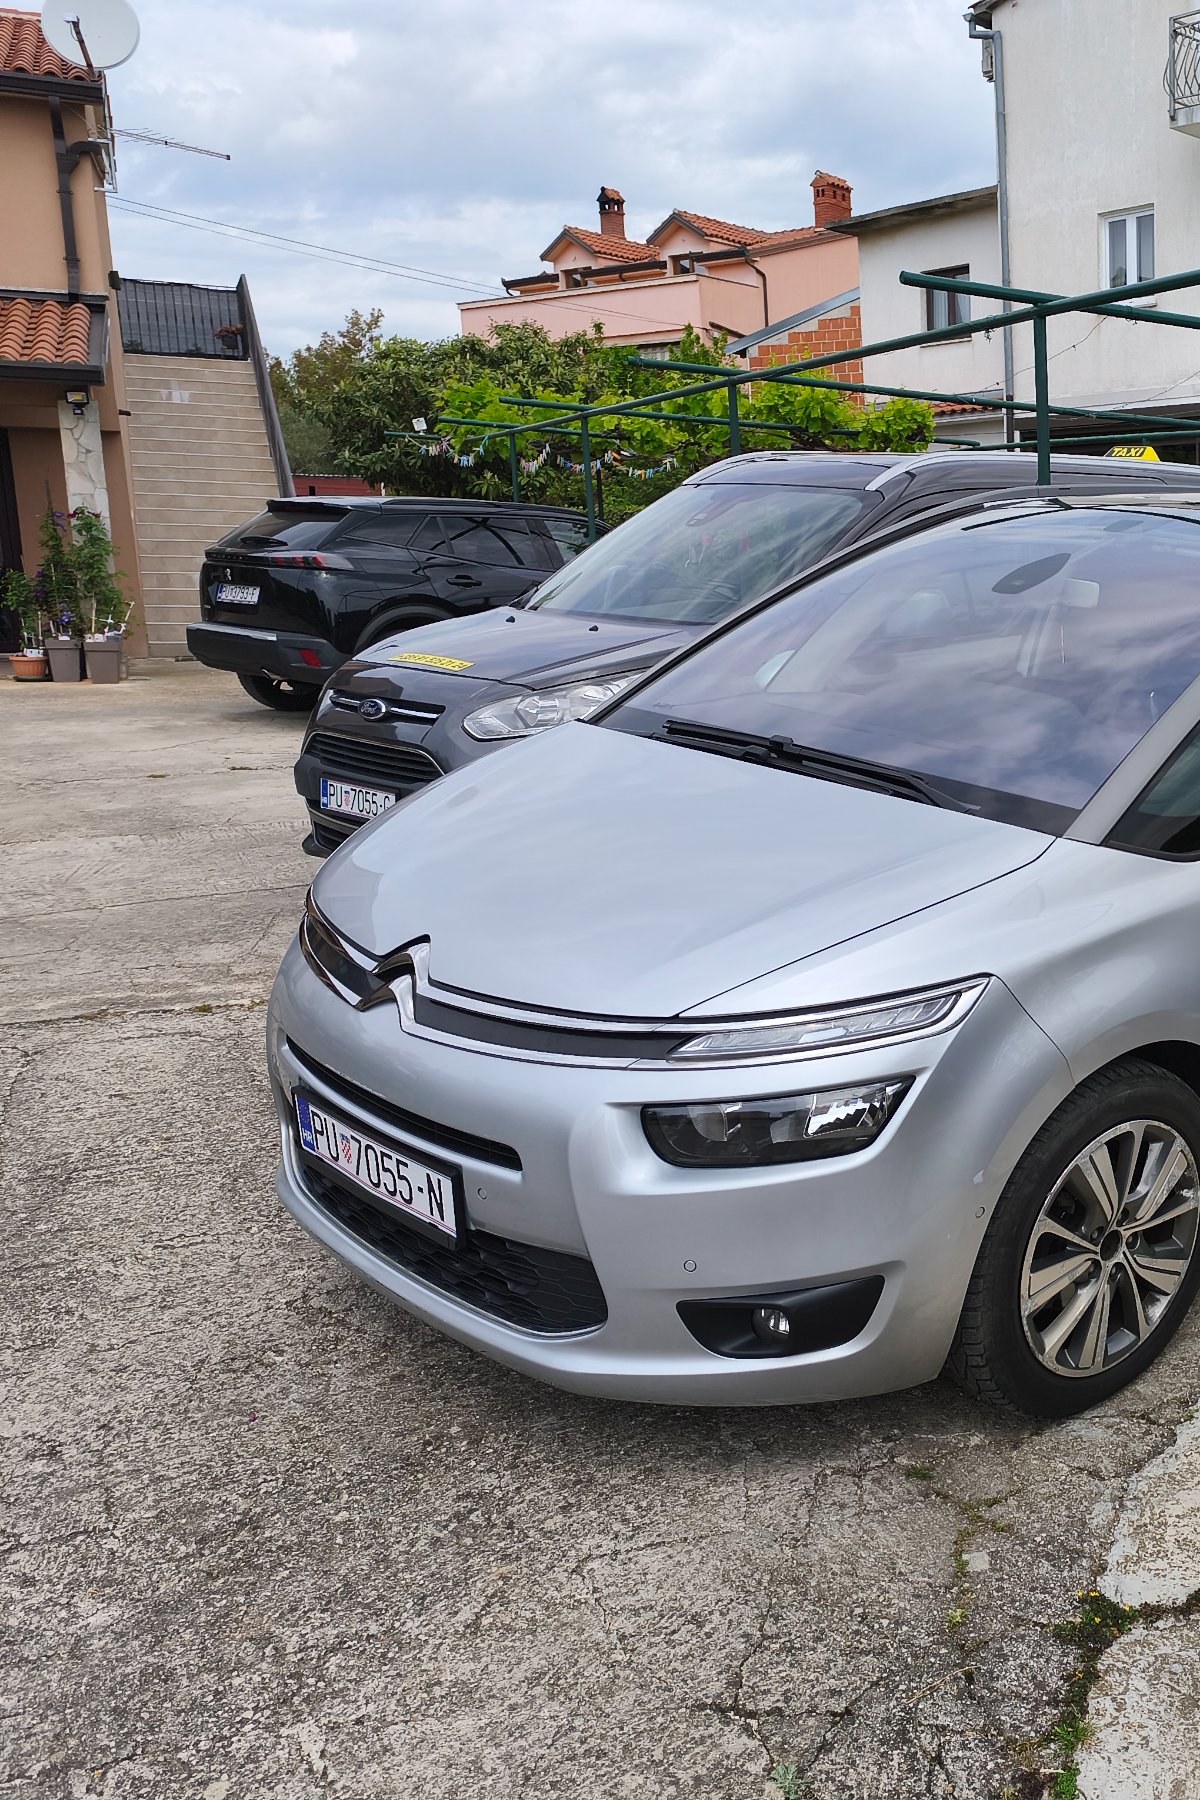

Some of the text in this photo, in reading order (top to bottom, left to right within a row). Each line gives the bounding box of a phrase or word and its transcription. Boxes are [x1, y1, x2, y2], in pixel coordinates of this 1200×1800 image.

[1111, 447, 1145, 457] TAXI
[328, 783, 343, 808] PU
[302, 1127, 314, 1144] HR
[310, 1109, 446, 1222] PU 7055-N
